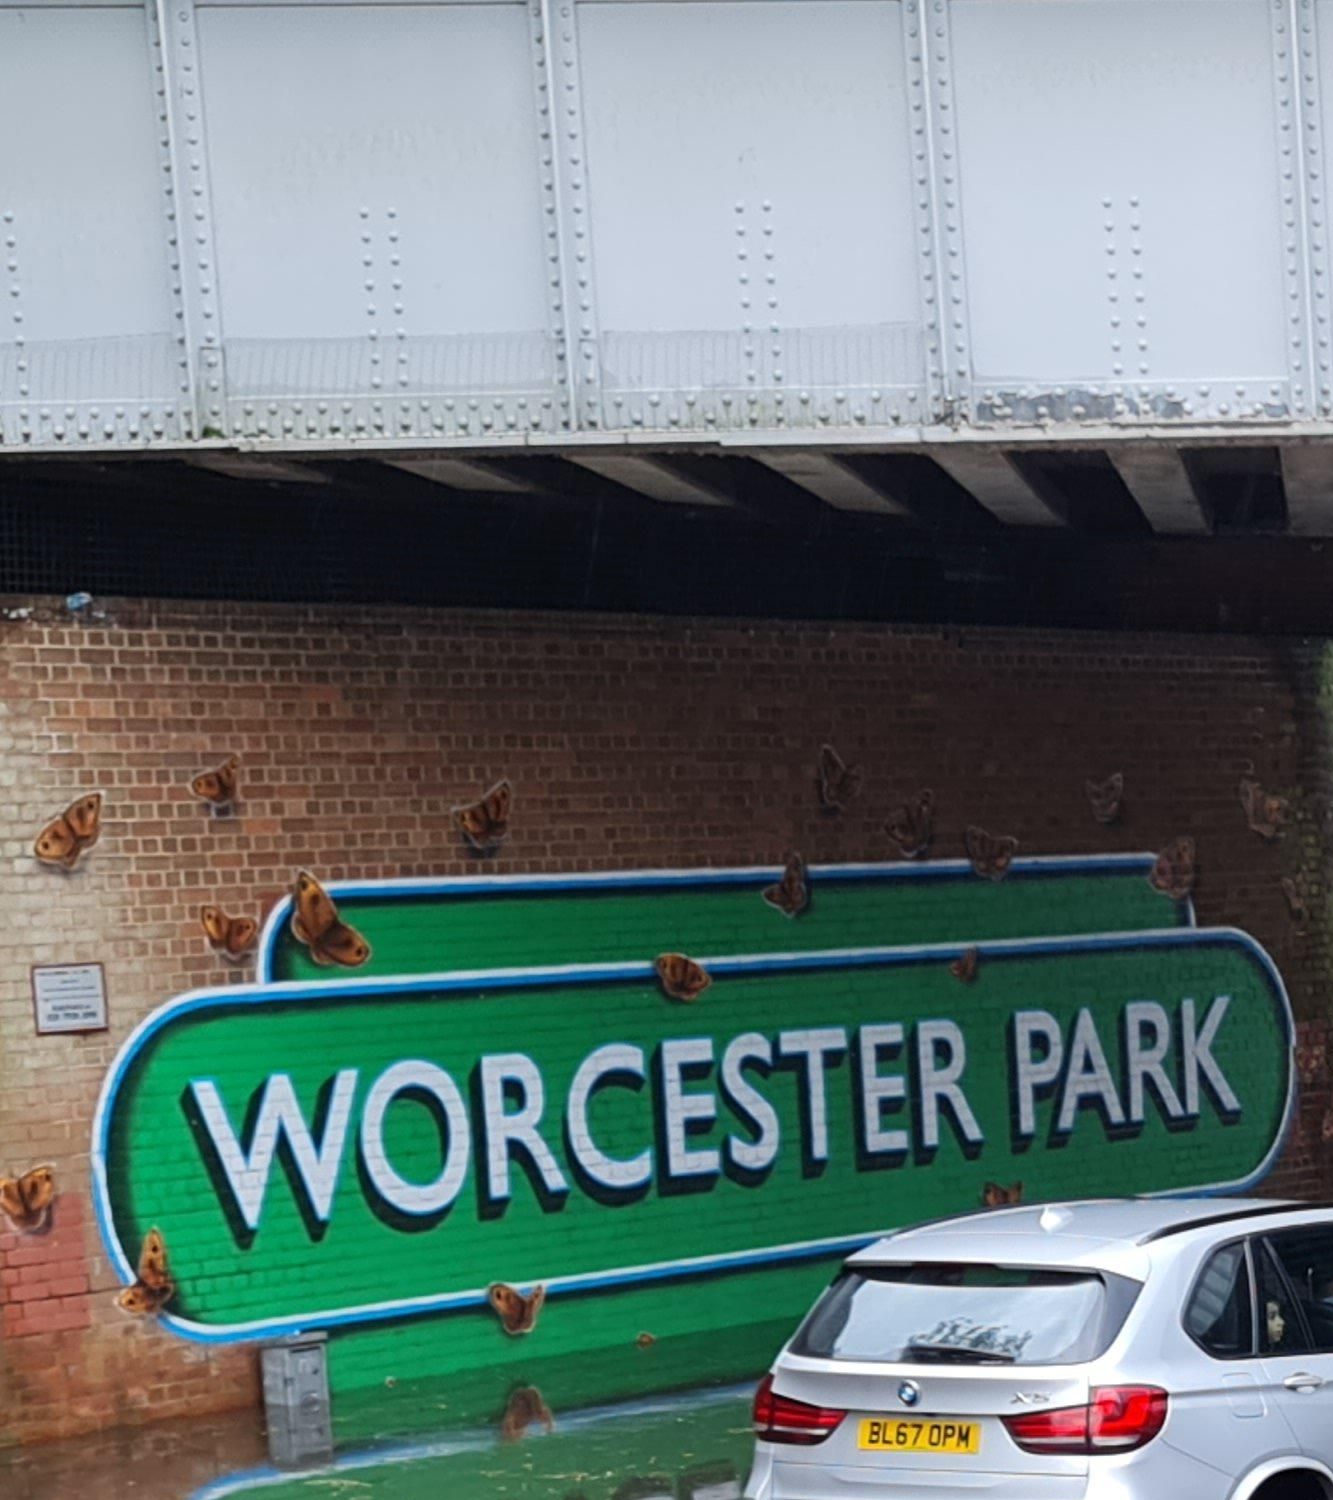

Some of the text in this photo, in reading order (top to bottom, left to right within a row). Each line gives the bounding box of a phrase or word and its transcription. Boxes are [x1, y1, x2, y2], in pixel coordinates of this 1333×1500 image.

[190, 995, 1242, 1231] WORCESTER PARK
[867, 1421, 971, 1449] BL67 OPM
